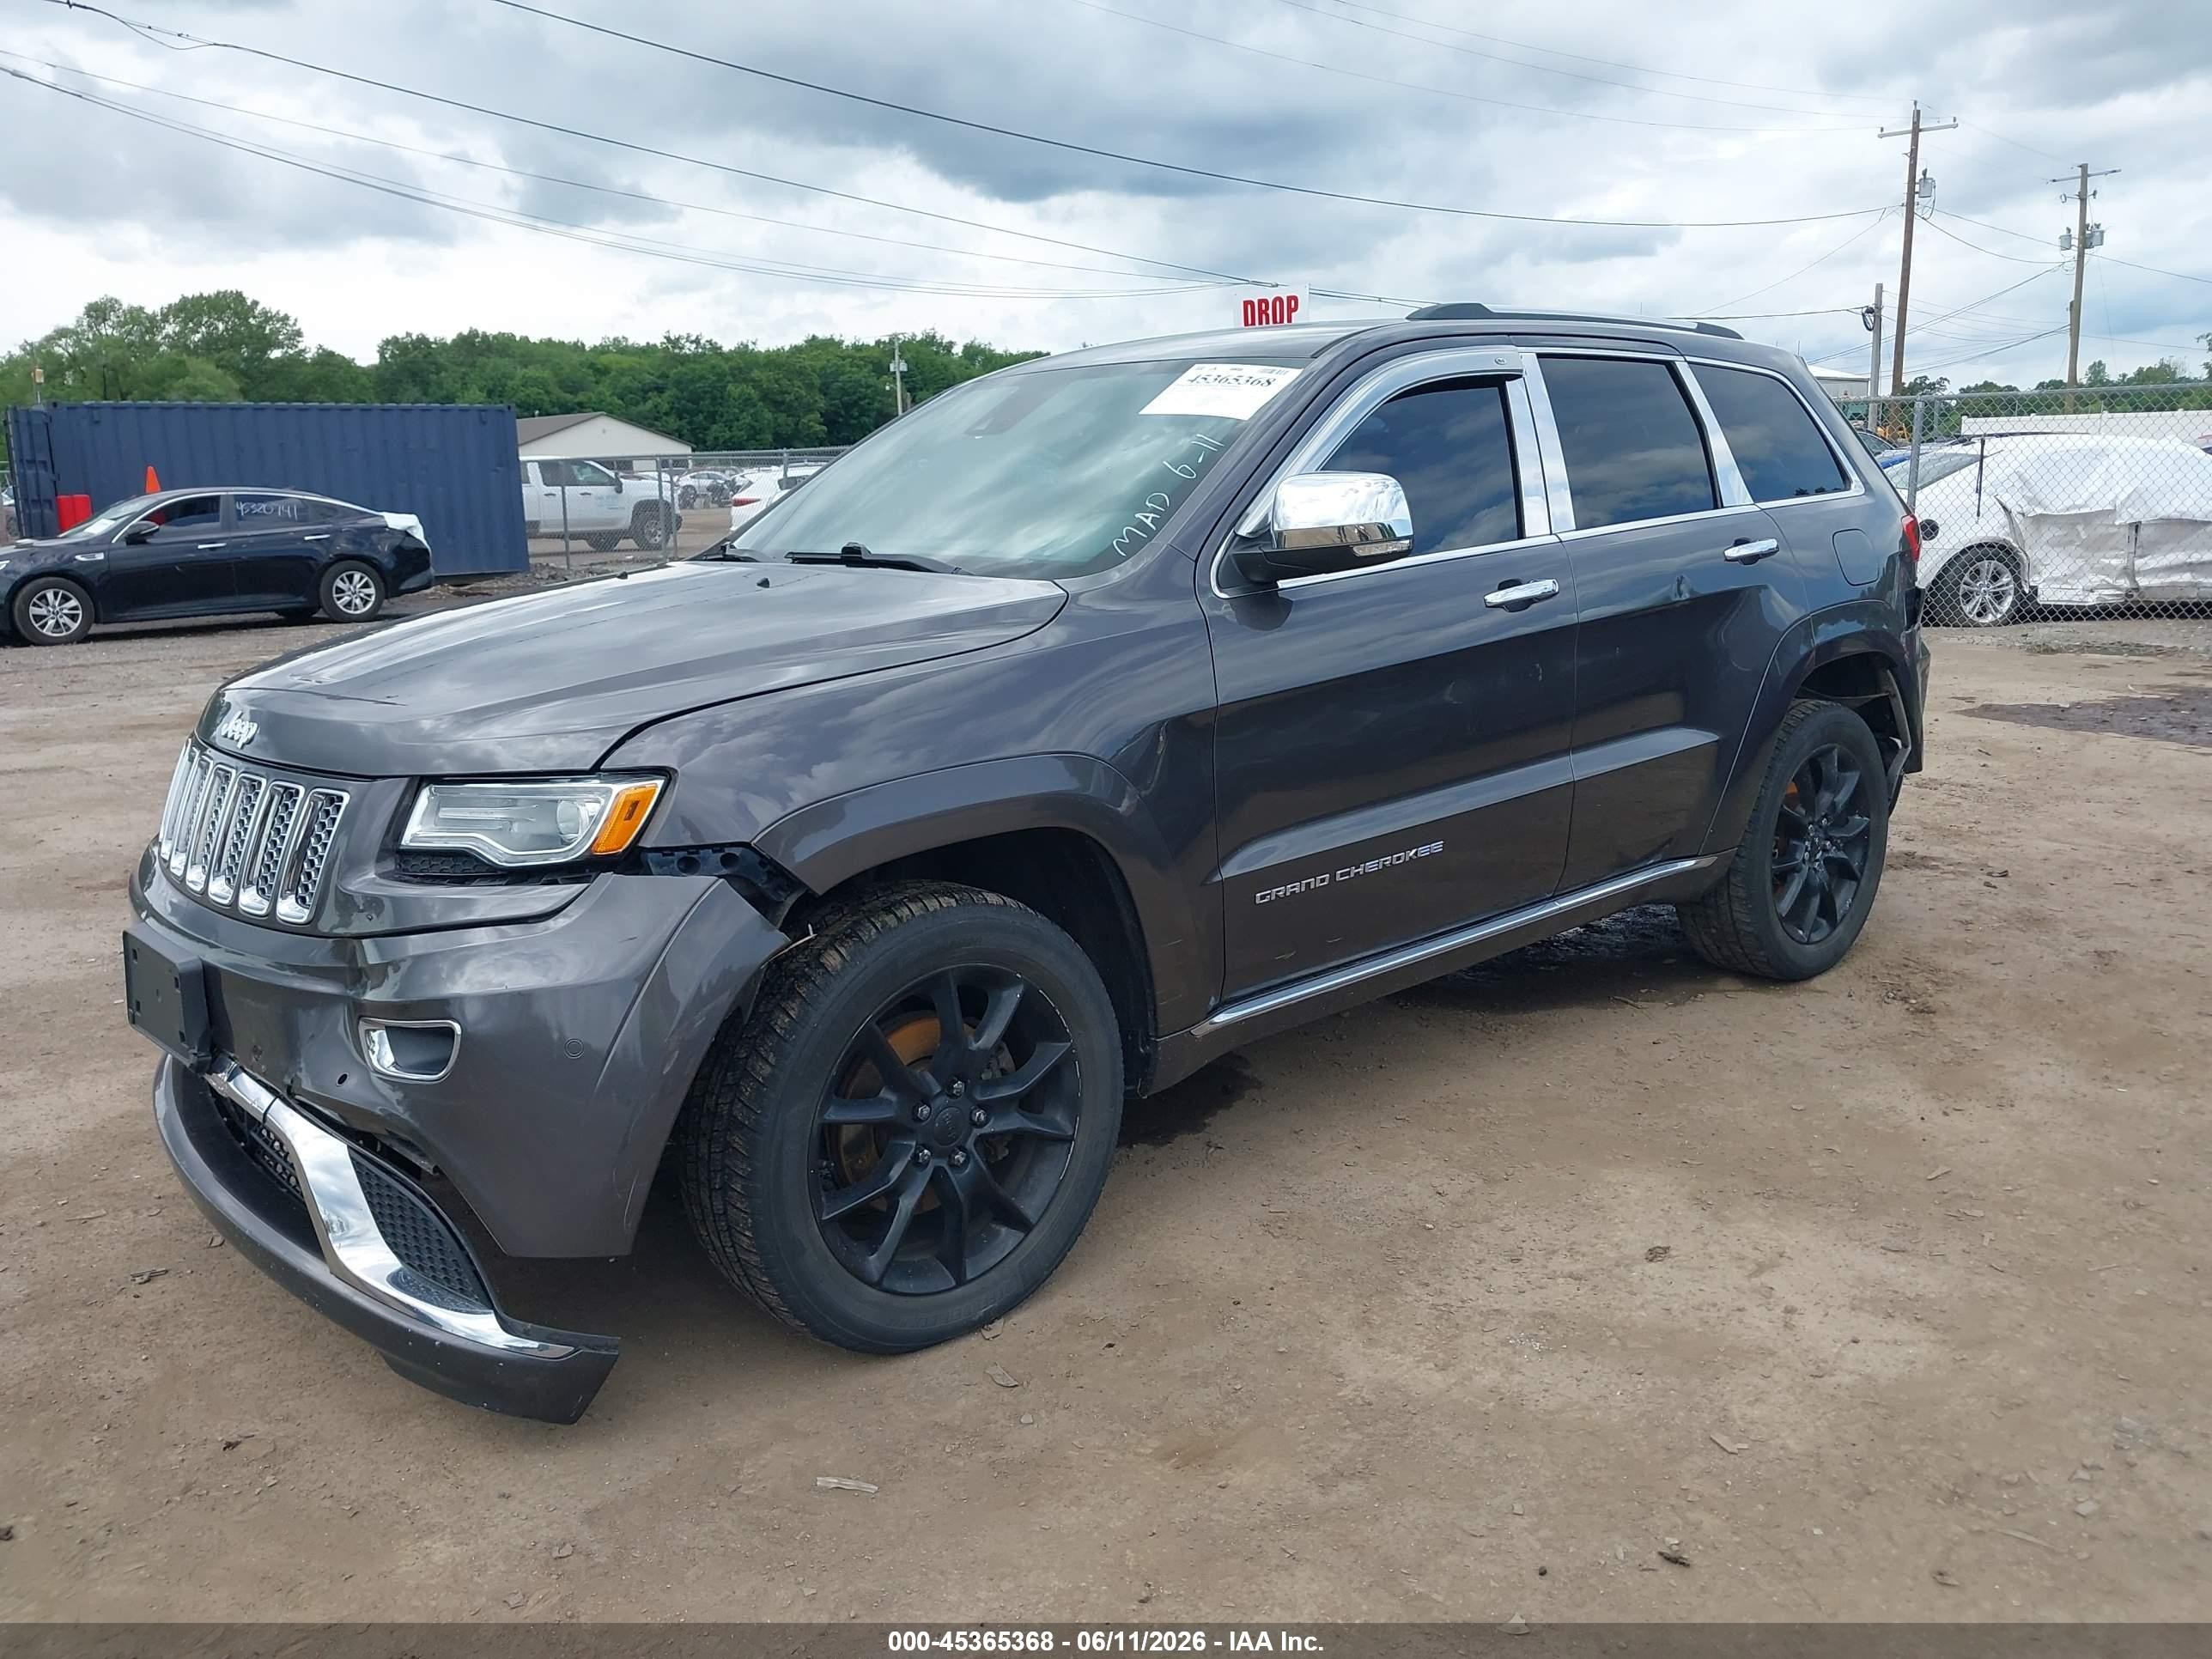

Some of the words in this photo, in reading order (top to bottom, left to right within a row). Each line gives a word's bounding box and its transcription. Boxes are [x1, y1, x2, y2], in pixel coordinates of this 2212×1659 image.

[1243, 295, 1299, 327] DROP
[1188, 374, 1276, 387] 45365368
[1112, 492, 1170, 556] MAD
[221, 710, 258, 749] Jeep
[1255, 872, 1330, 904] GRAND
[1335, 840, 1444, 883] CHEROKEE
